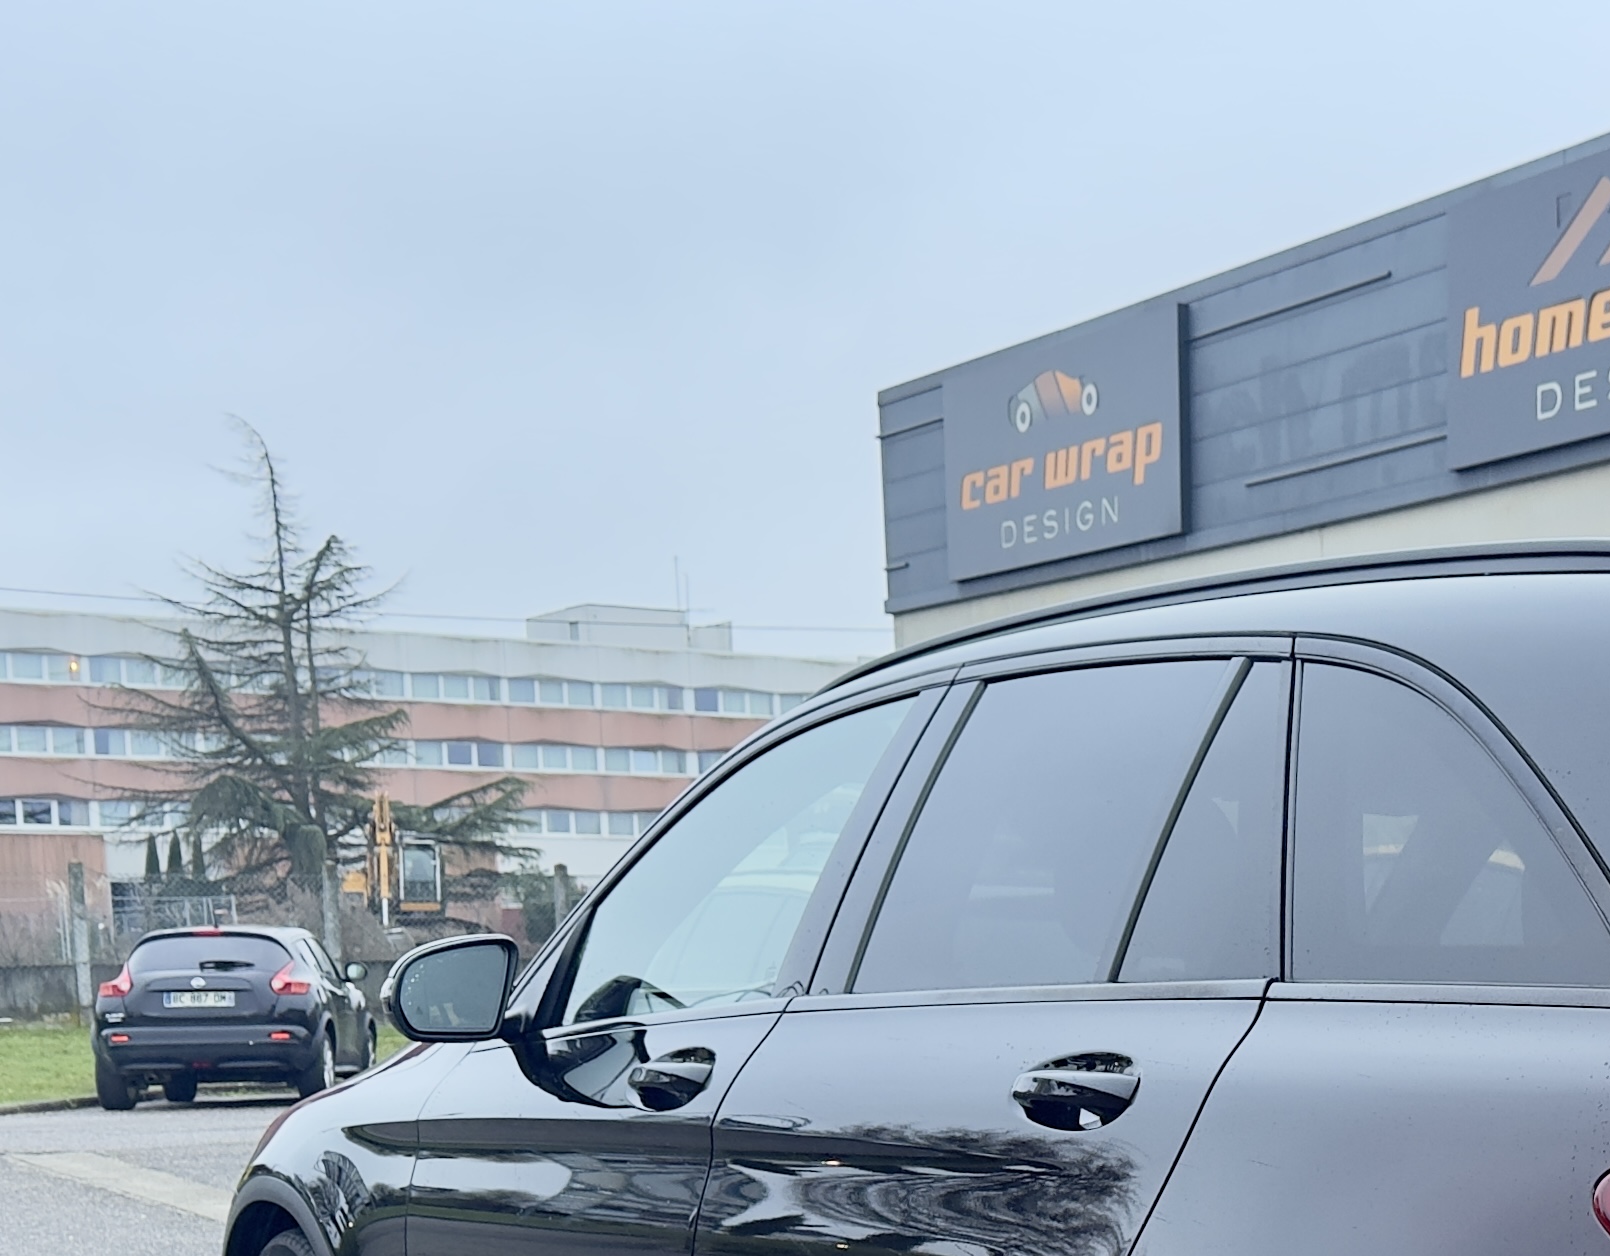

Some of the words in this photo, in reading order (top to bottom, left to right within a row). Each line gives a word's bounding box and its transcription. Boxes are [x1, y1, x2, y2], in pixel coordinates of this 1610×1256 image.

[960, 456, 1034, 512] car
[1043, 421, 1163, 490] wrap
[1000, 495, 1120, 550] DESIGN
